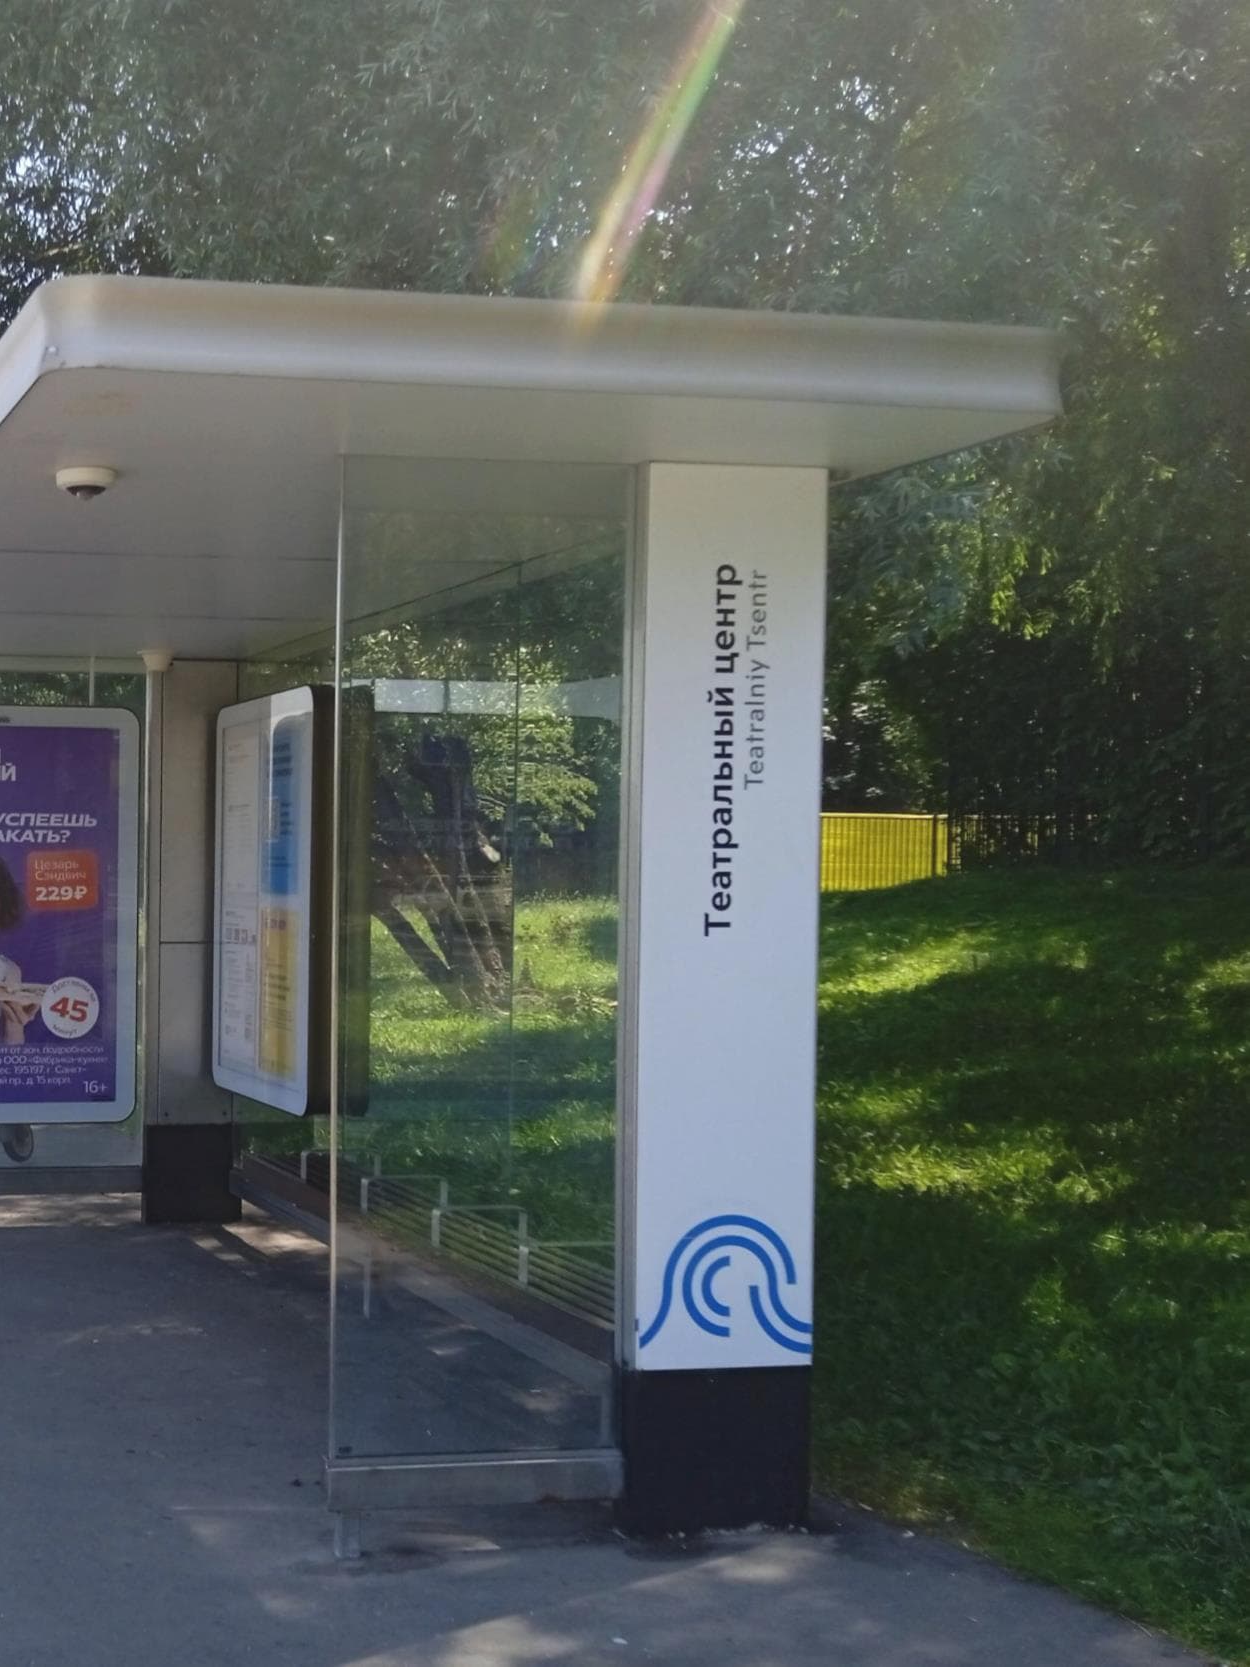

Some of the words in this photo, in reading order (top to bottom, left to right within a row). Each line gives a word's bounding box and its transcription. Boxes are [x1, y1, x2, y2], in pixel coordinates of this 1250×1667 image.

[715, 563, 743, 674] центр
[746, 569, 768, 650] Tsentr
[744, 658, 770, 790] Teatralniy
[703, 687, 739, 937] Театральный
[34, 859, 79, 871] Цезарь
[50, 996, 89, 1022] 45
[83, 1080, 108, 1093] 16+
